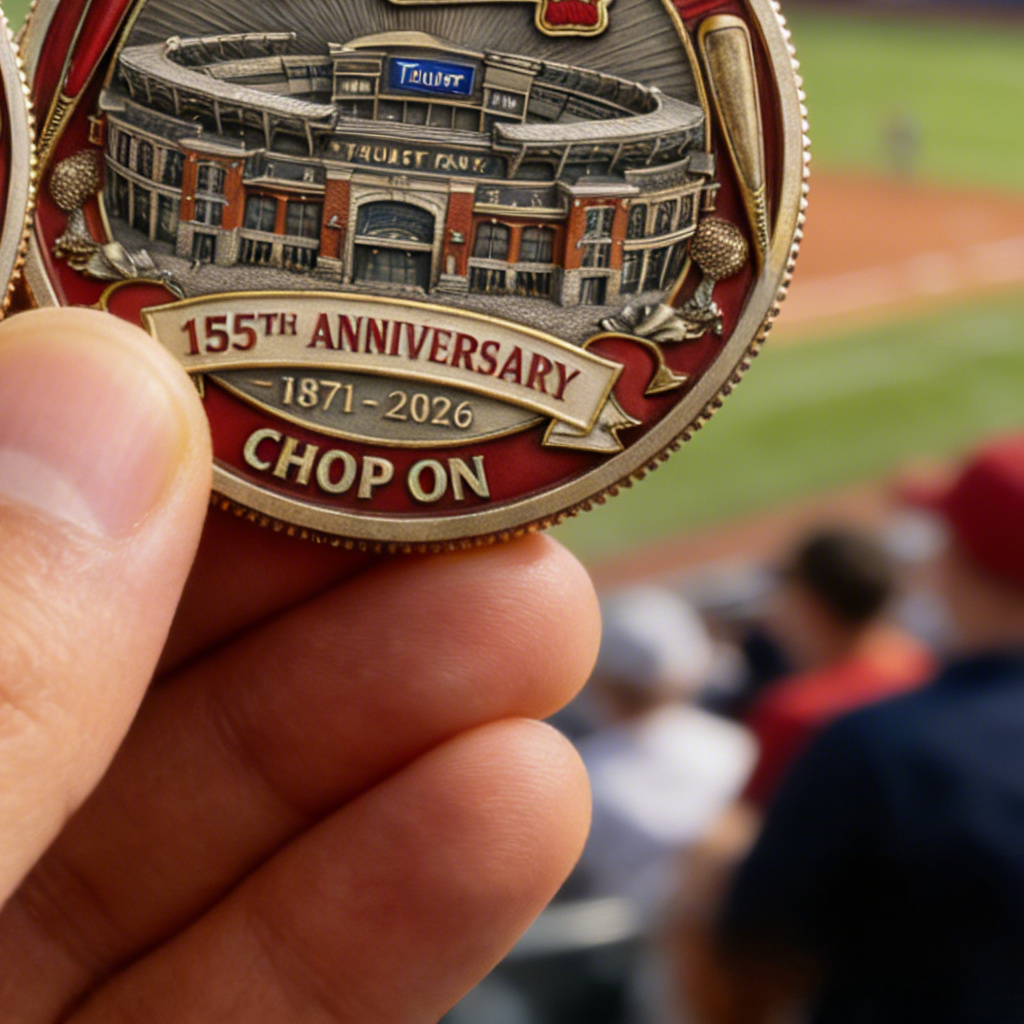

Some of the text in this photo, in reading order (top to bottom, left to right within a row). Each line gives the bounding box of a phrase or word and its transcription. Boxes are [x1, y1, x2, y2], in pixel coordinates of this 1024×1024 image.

[180, 312, 581, 402] 155TH ANNIVERSARY
[281, 377, 355, 414] 1871
[385, 390, 473, 428] 2026
[242, 428, 490, 503] CHOP ON
